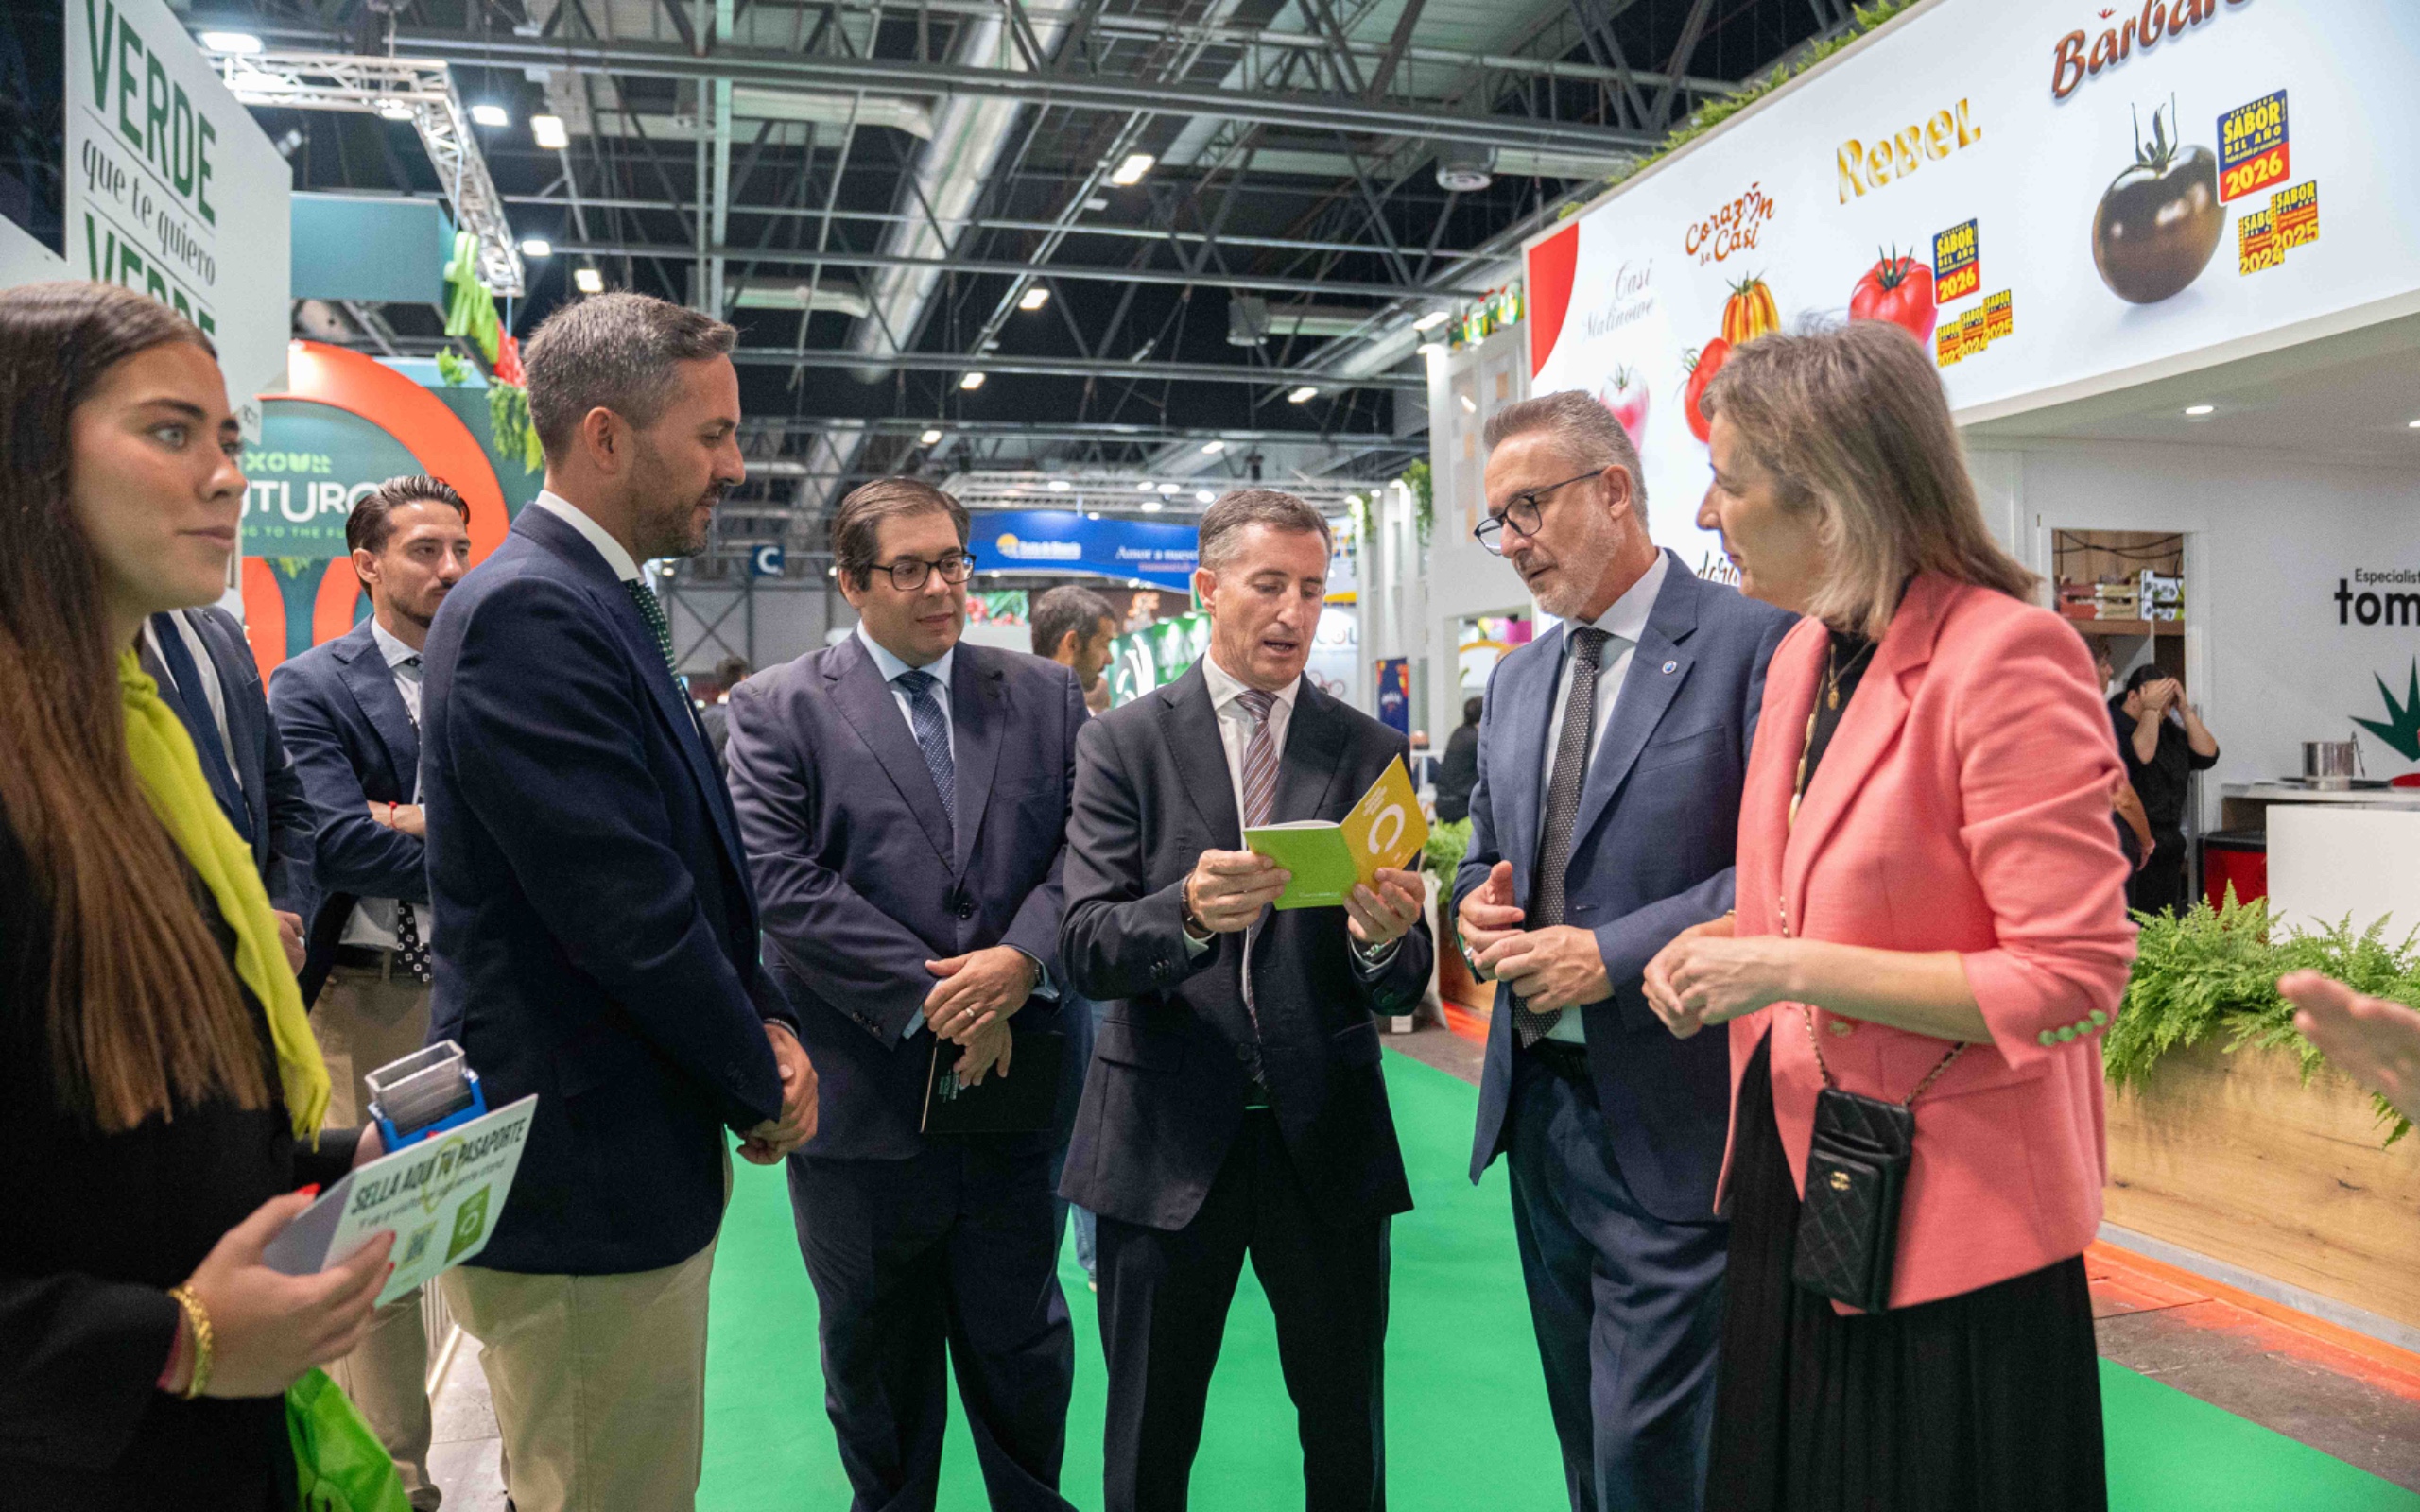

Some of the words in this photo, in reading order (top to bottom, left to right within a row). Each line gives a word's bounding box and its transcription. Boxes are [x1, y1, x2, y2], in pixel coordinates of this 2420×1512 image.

[85, 0, 216, 227] VERDE
[2223, 101, 2281, 145] SABOR
[2224, 138, 2248, 156] DEL
[2225, 150, 2283, 198] 2026
[2276, 180, 2316, 211] SABOR
[82, 137, 127, 205] que
[132, 176, 152, 230] te
[158, 210, 216, 287] quiero
[1685, 180, 1776, 256] Corazón
[2243, 209, 2272, 234] SABO
[1714, 220, 1761, 263] Casi
[1936, 227, 1975, 260] SABOR
[2271, 217, 2320, 253] 2025
[1938, 266, 1977, 302] 2026
[757, 546, 780, 574] C
[2334, 577, 2420, 626] tom
[351, 1172, 402, 1215] SELLA
[455, 1117, 527, 1165] PASAPORTE
